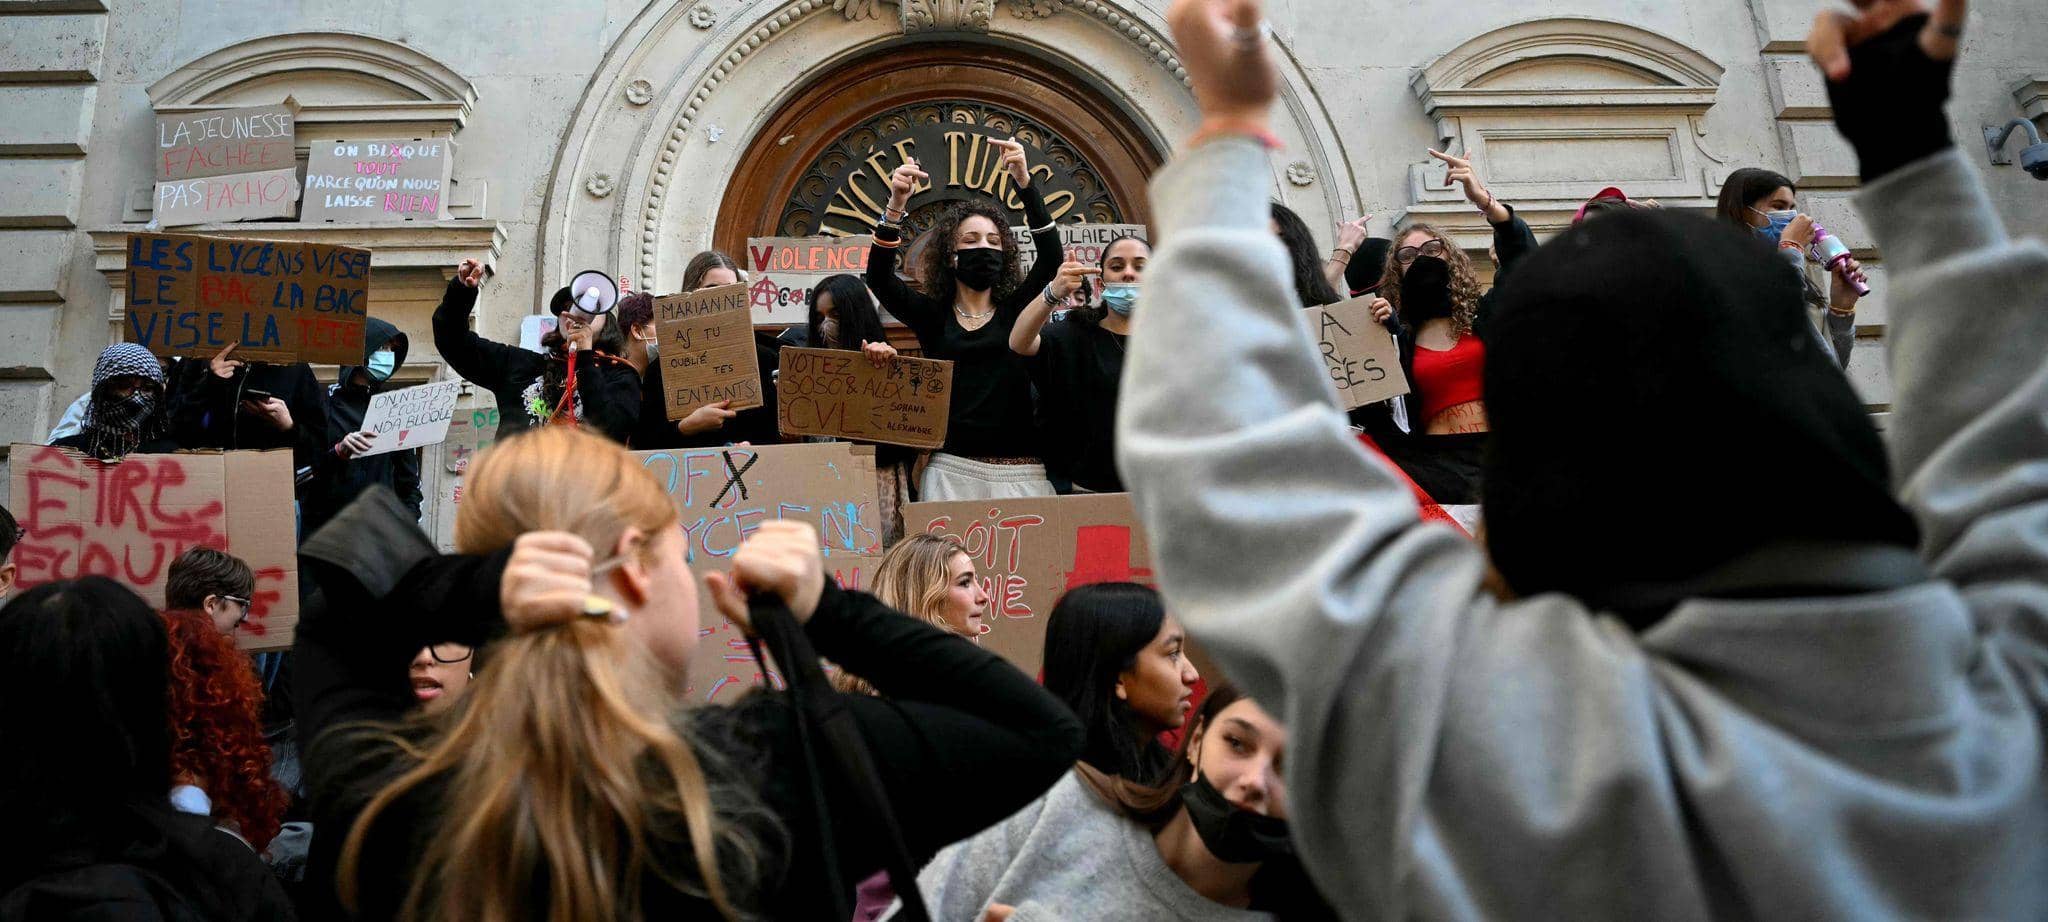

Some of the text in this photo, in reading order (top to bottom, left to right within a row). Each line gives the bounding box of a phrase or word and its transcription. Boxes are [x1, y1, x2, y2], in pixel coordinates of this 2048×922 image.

[161, 113, 292, 148] LA JEUNESSE
[334, 145, 358, 157] ON
[353, 160, 402, 175] TOUT
[160, 176, 288, 212] PAS FACHO
[306, 174, 352, 189] PARCE
[402, 178, 440, 190] NOUS
[325, 191, 439, 214] LAISSE RIEN
[131, 237, 193, 272] LES
[131, 270, 177, 305] LE
[273, 281, 304, 312] LA
[314, 284, 365, 316] BAC
[662, 293, 745, 319] MARIANNE
[241, 312, 281, 347] LA
[676, 326, 720, 349] AS TU
[713, 364, 734, 374] TES
[786, 353, 852, 376] VOTEZ
[783, 375, 905, 400] SOSO & ALEX
[375, 394, 398, 409] ON
[787, 396, 864, 433] CVL
[18, 447, 223, 540] ÊTRE
